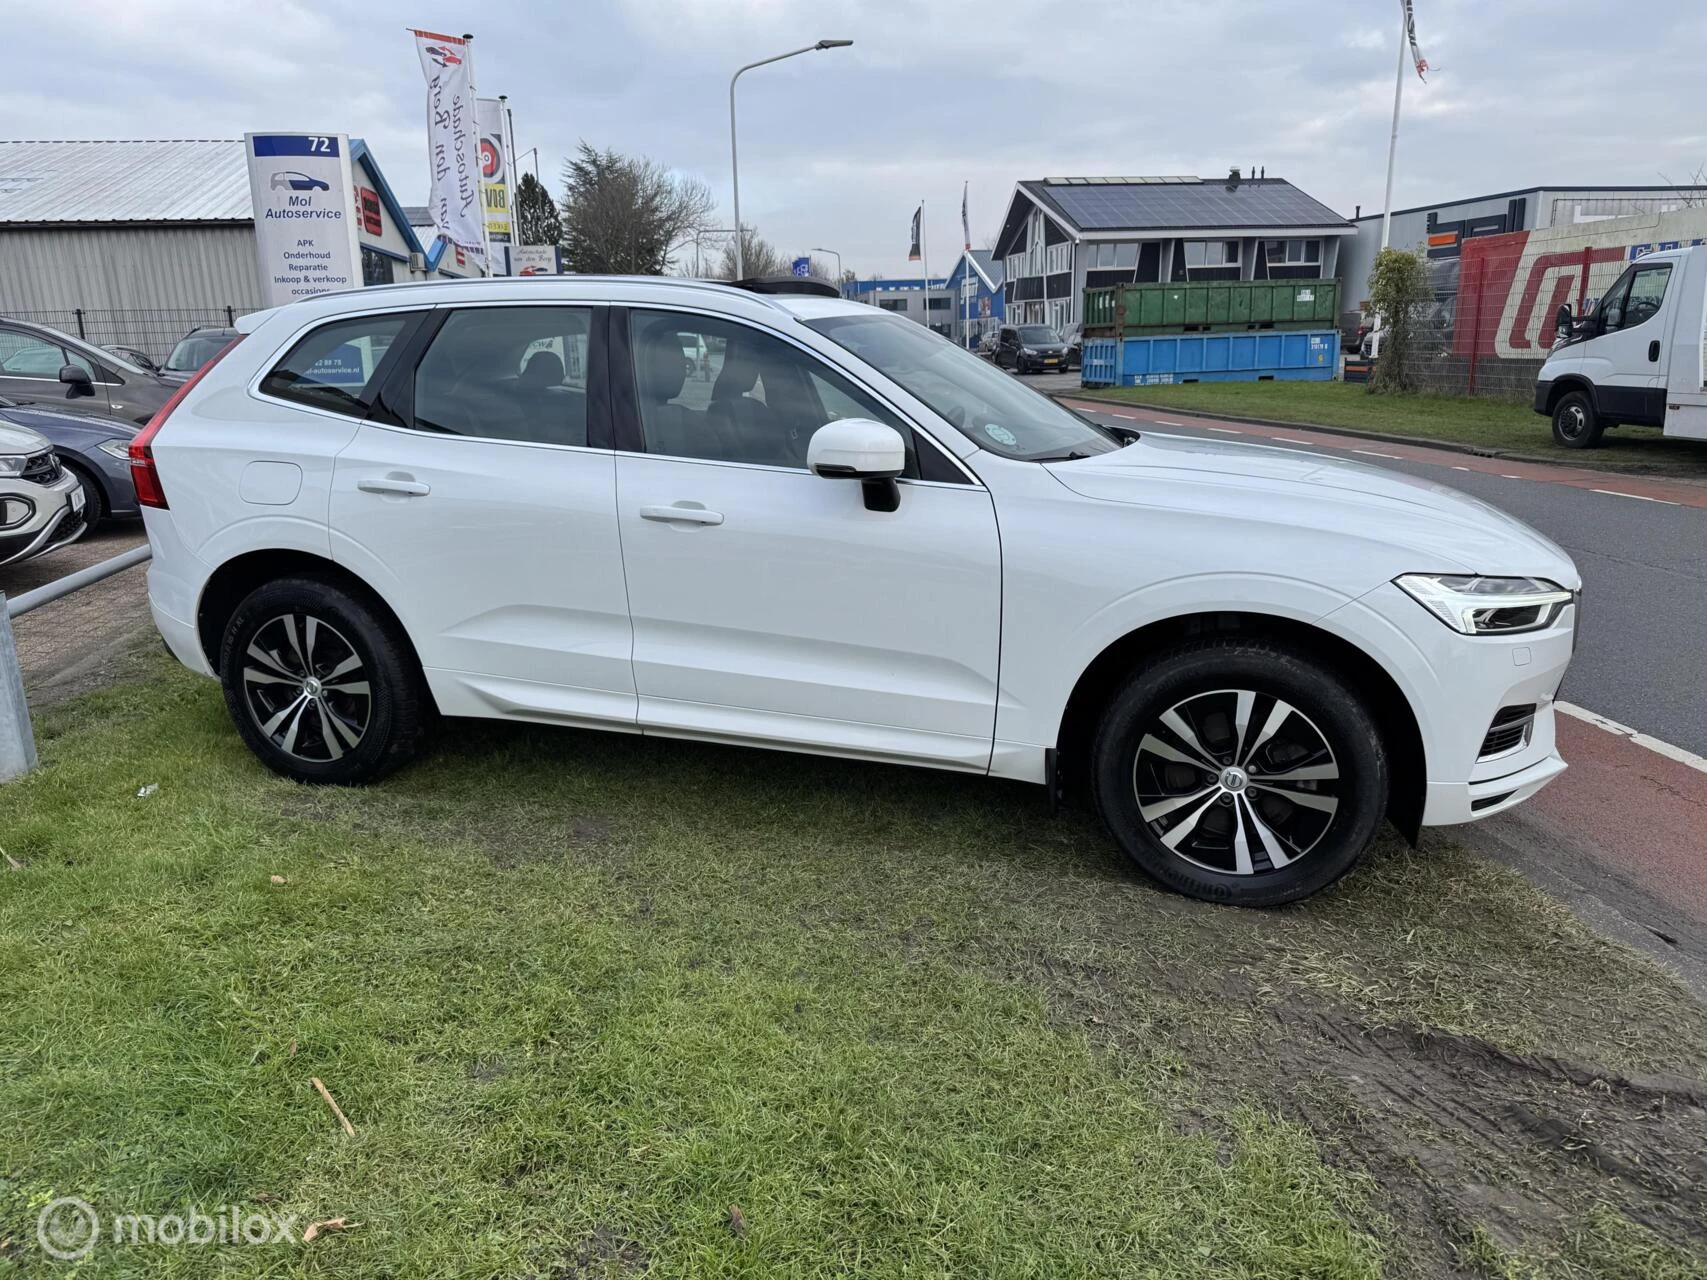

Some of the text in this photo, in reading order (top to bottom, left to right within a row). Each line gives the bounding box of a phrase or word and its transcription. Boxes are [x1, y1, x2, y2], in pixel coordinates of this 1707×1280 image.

[308, 136, 331, 152] 72
[288, 195, 312, 207] Mol
[265, 208, 342, 219] Autoservice
[297, 239, 314, 247] APK
[283, 251, 331, 259] Onderhoud
[288, 263, 328, 272] Reparatie
[274, 275, 347, 285] Inkoop & verkoop
